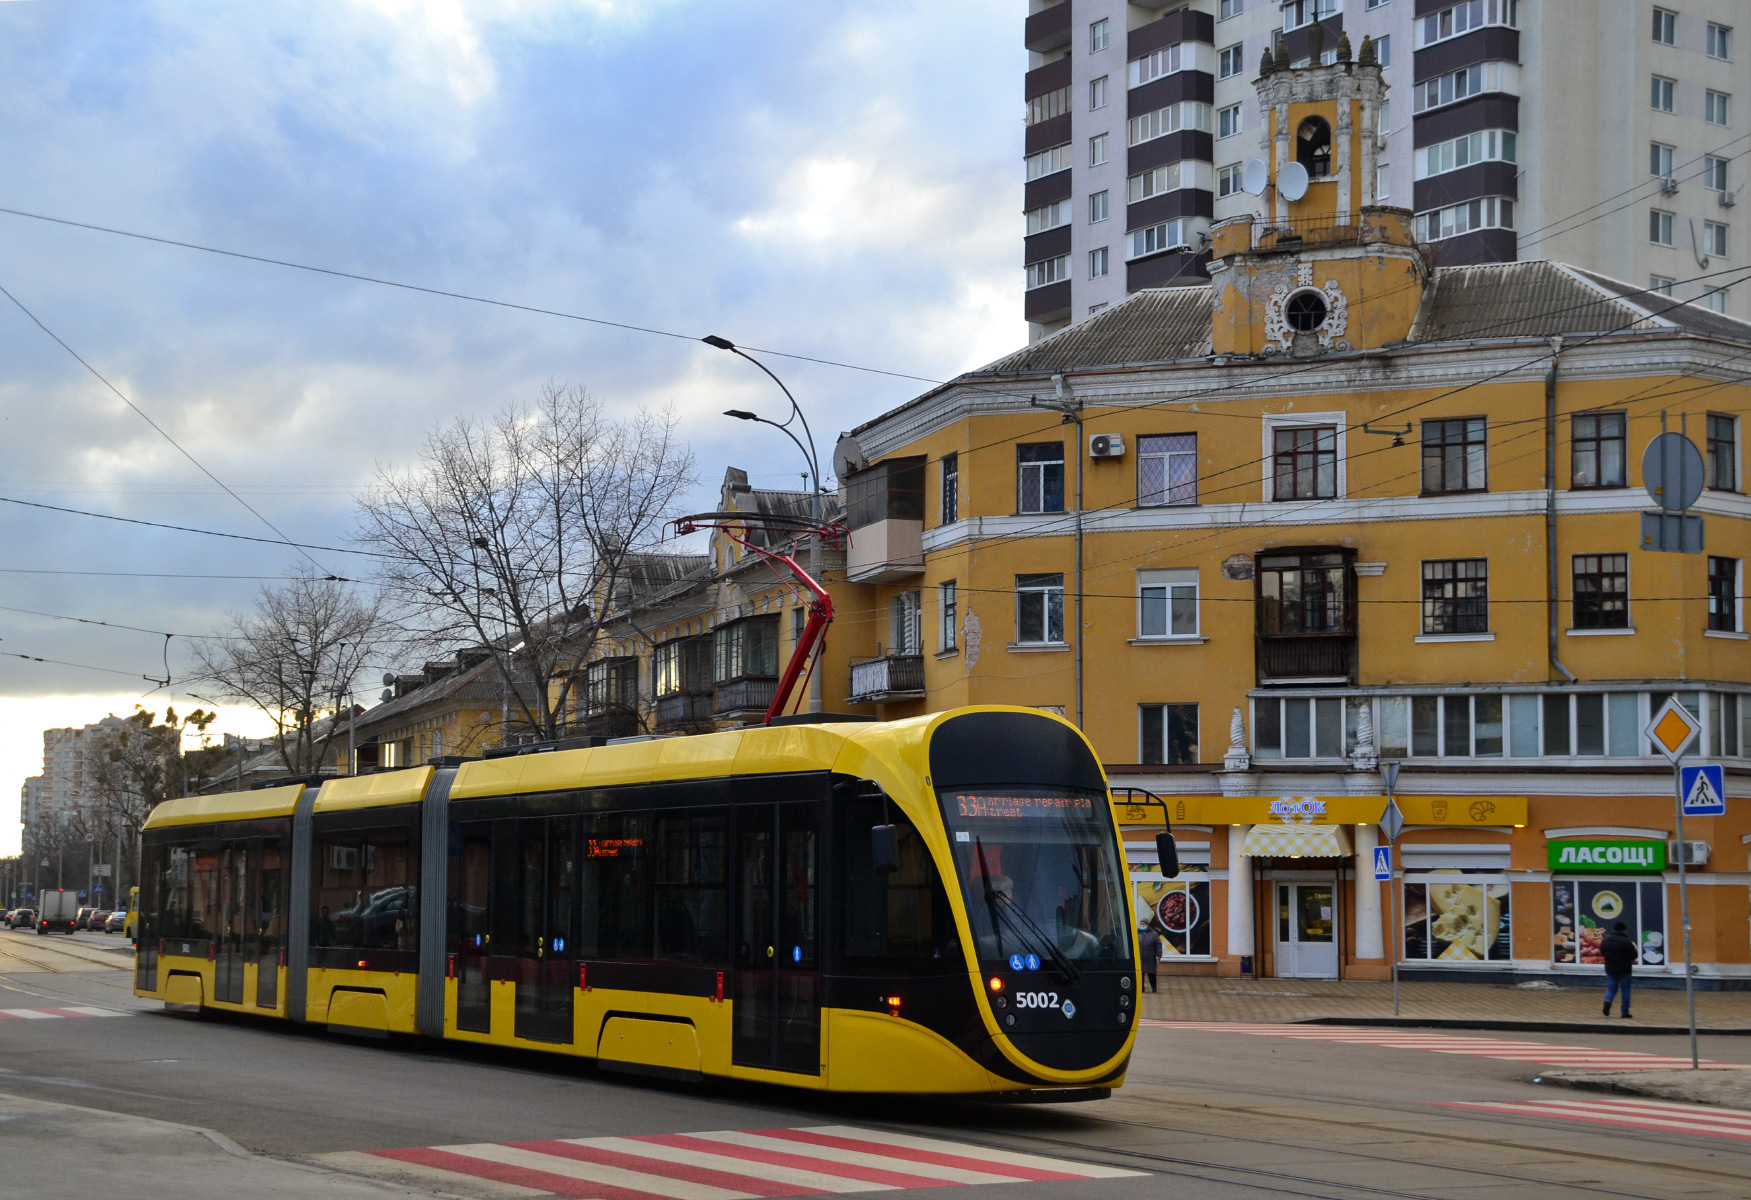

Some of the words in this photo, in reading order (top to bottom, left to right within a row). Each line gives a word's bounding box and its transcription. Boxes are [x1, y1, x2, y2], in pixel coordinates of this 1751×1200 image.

[1034, 798, 1072, 808] repair
[1559, 846, 1654, 867] ЛАСОЩІ
[1016, 991, 1060, 1008] 5002
